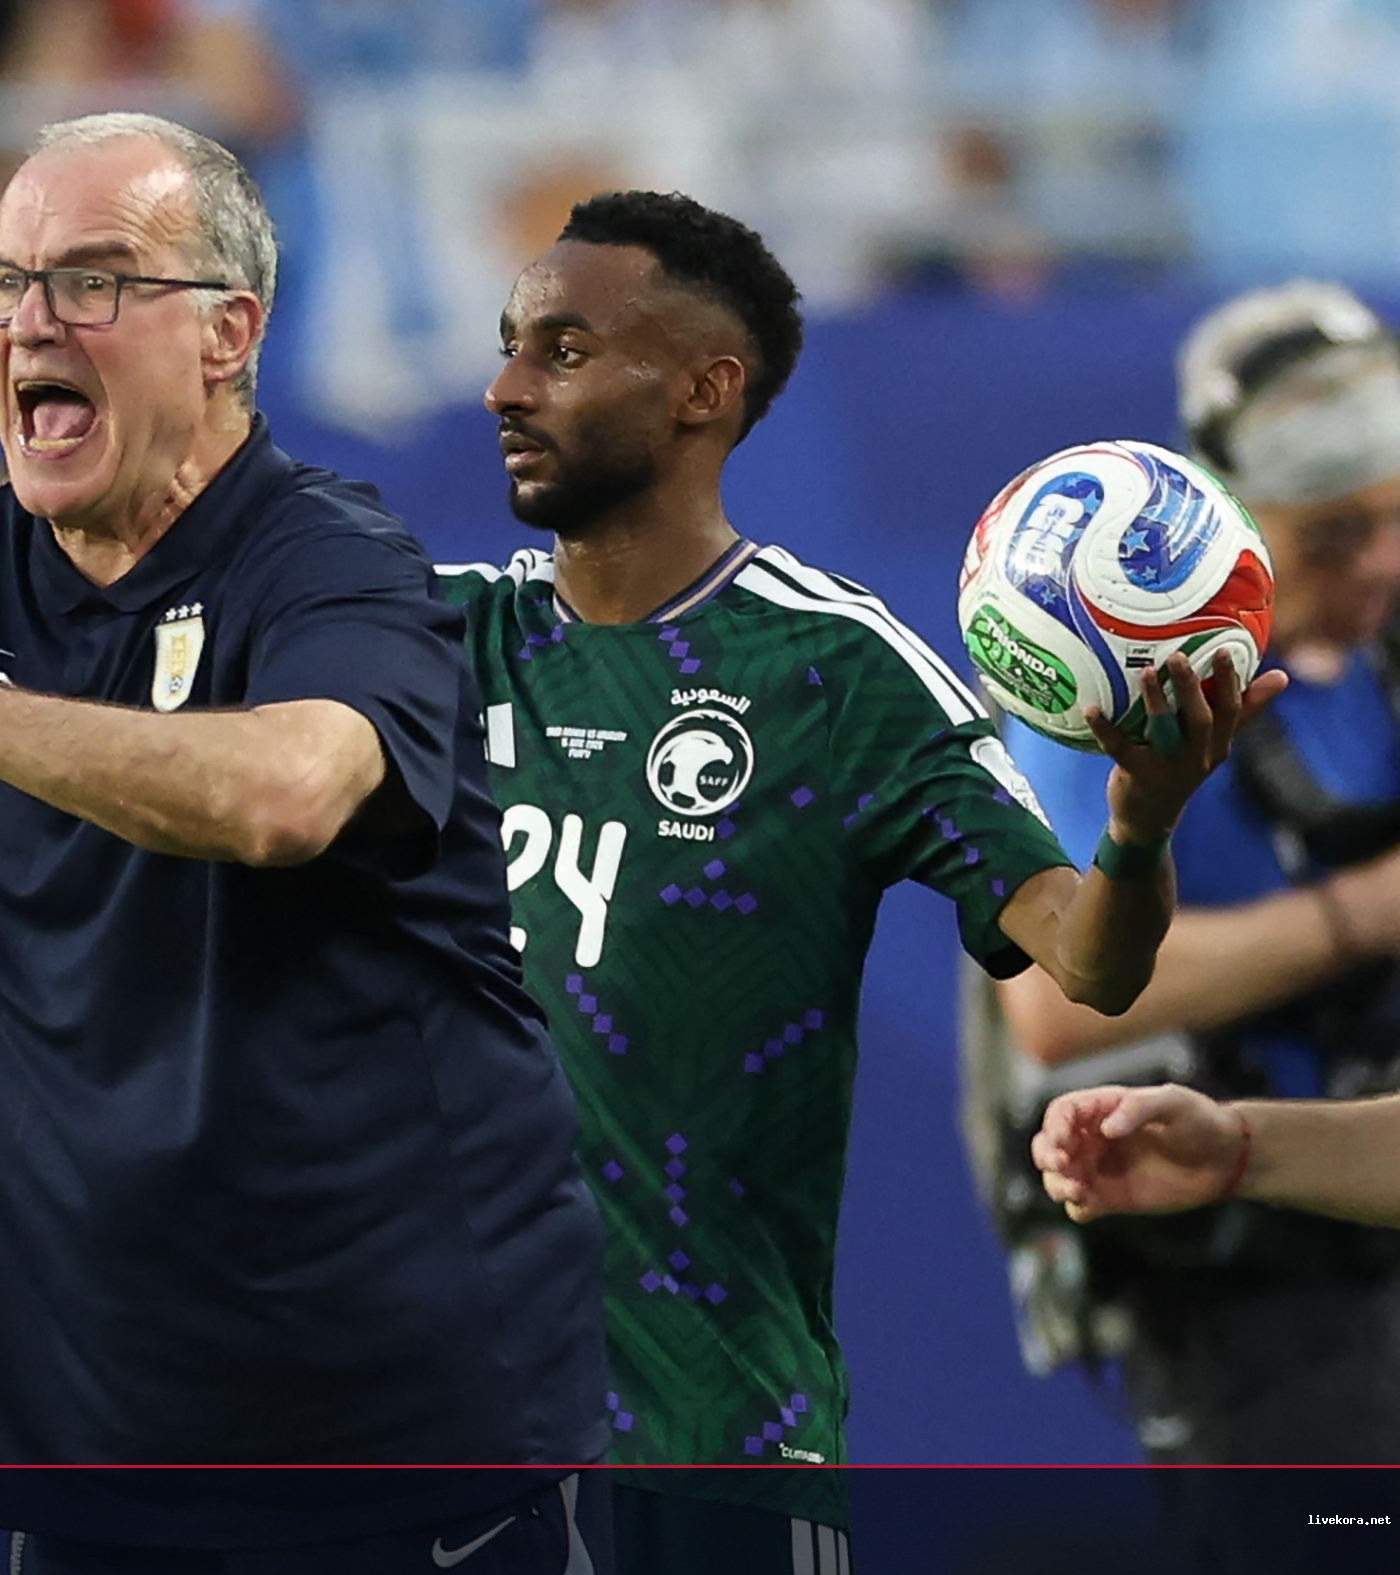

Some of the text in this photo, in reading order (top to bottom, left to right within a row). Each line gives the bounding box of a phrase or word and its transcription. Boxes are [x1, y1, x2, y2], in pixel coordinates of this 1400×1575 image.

[986, 616, 1058, 681] TRIONDA
[670, 687, 752, 715] السعودية
[699, 774, 729, 788] SAFF
[657, 819, 716, 842] SAUDI
